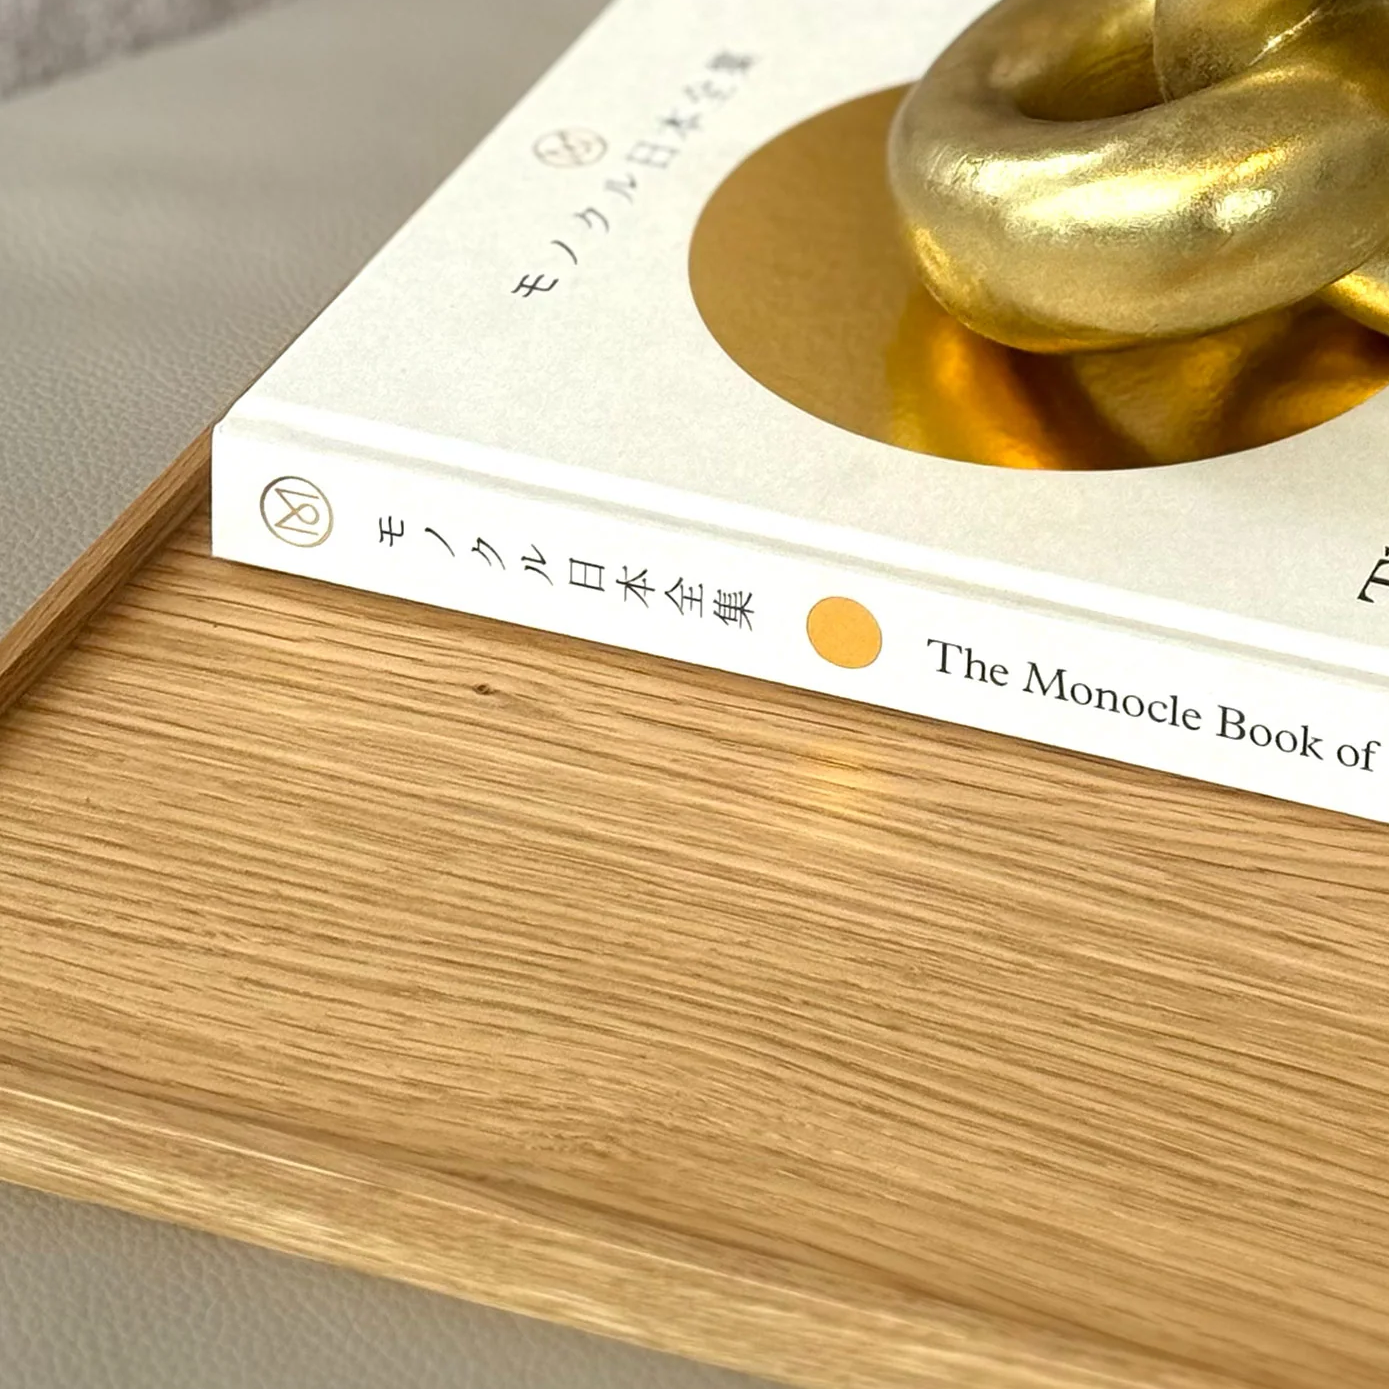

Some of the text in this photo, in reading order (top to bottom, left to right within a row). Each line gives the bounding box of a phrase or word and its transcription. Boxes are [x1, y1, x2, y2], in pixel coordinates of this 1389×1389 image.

[378, 514, 755, 631] モノクル日本全集
[926, 637, 1010, 688] The
[1021, 660, 1203, 732] Monocle
[1215, 704, 1325, 761] Book
[1335, 739, 1382, 772] of
